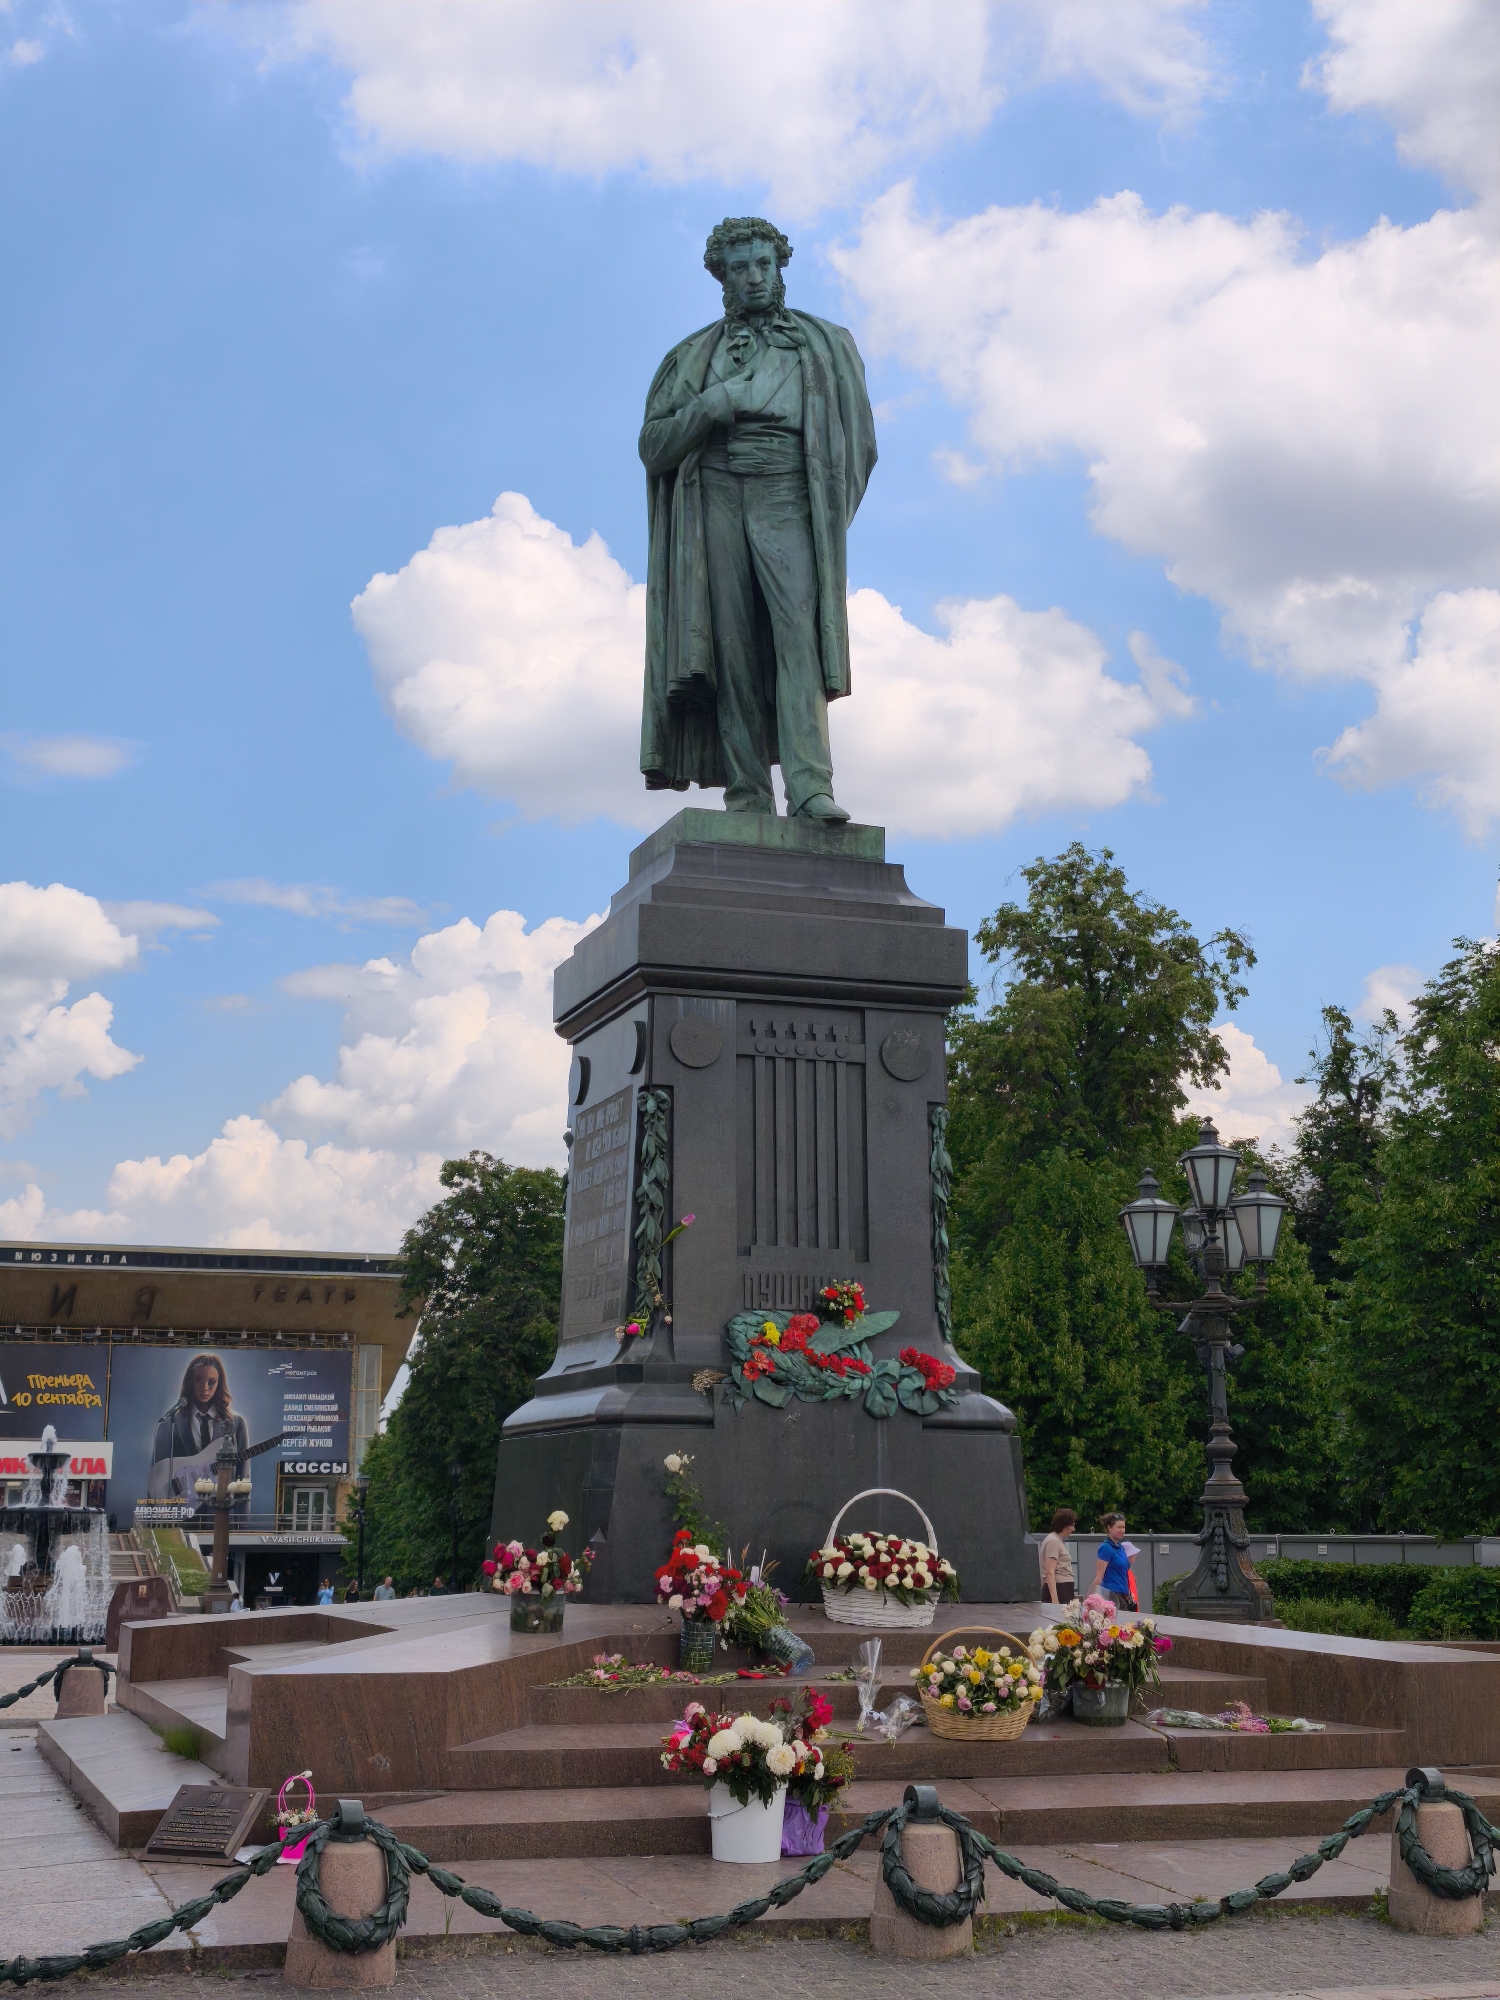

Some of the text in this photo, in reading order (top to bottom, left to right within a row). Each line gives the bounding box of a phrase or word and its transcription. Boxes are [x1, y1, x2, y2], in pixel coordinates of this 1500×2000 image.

[14, 1251, 128, 1265] МЮЗИКЛА
[27, 1373, 96, 1390] Премьера
[11, 1389, 103, 1409] 10 сентября
[282, 1437, 333, 1447] СЕРГЕЙ ЖУКОВ
